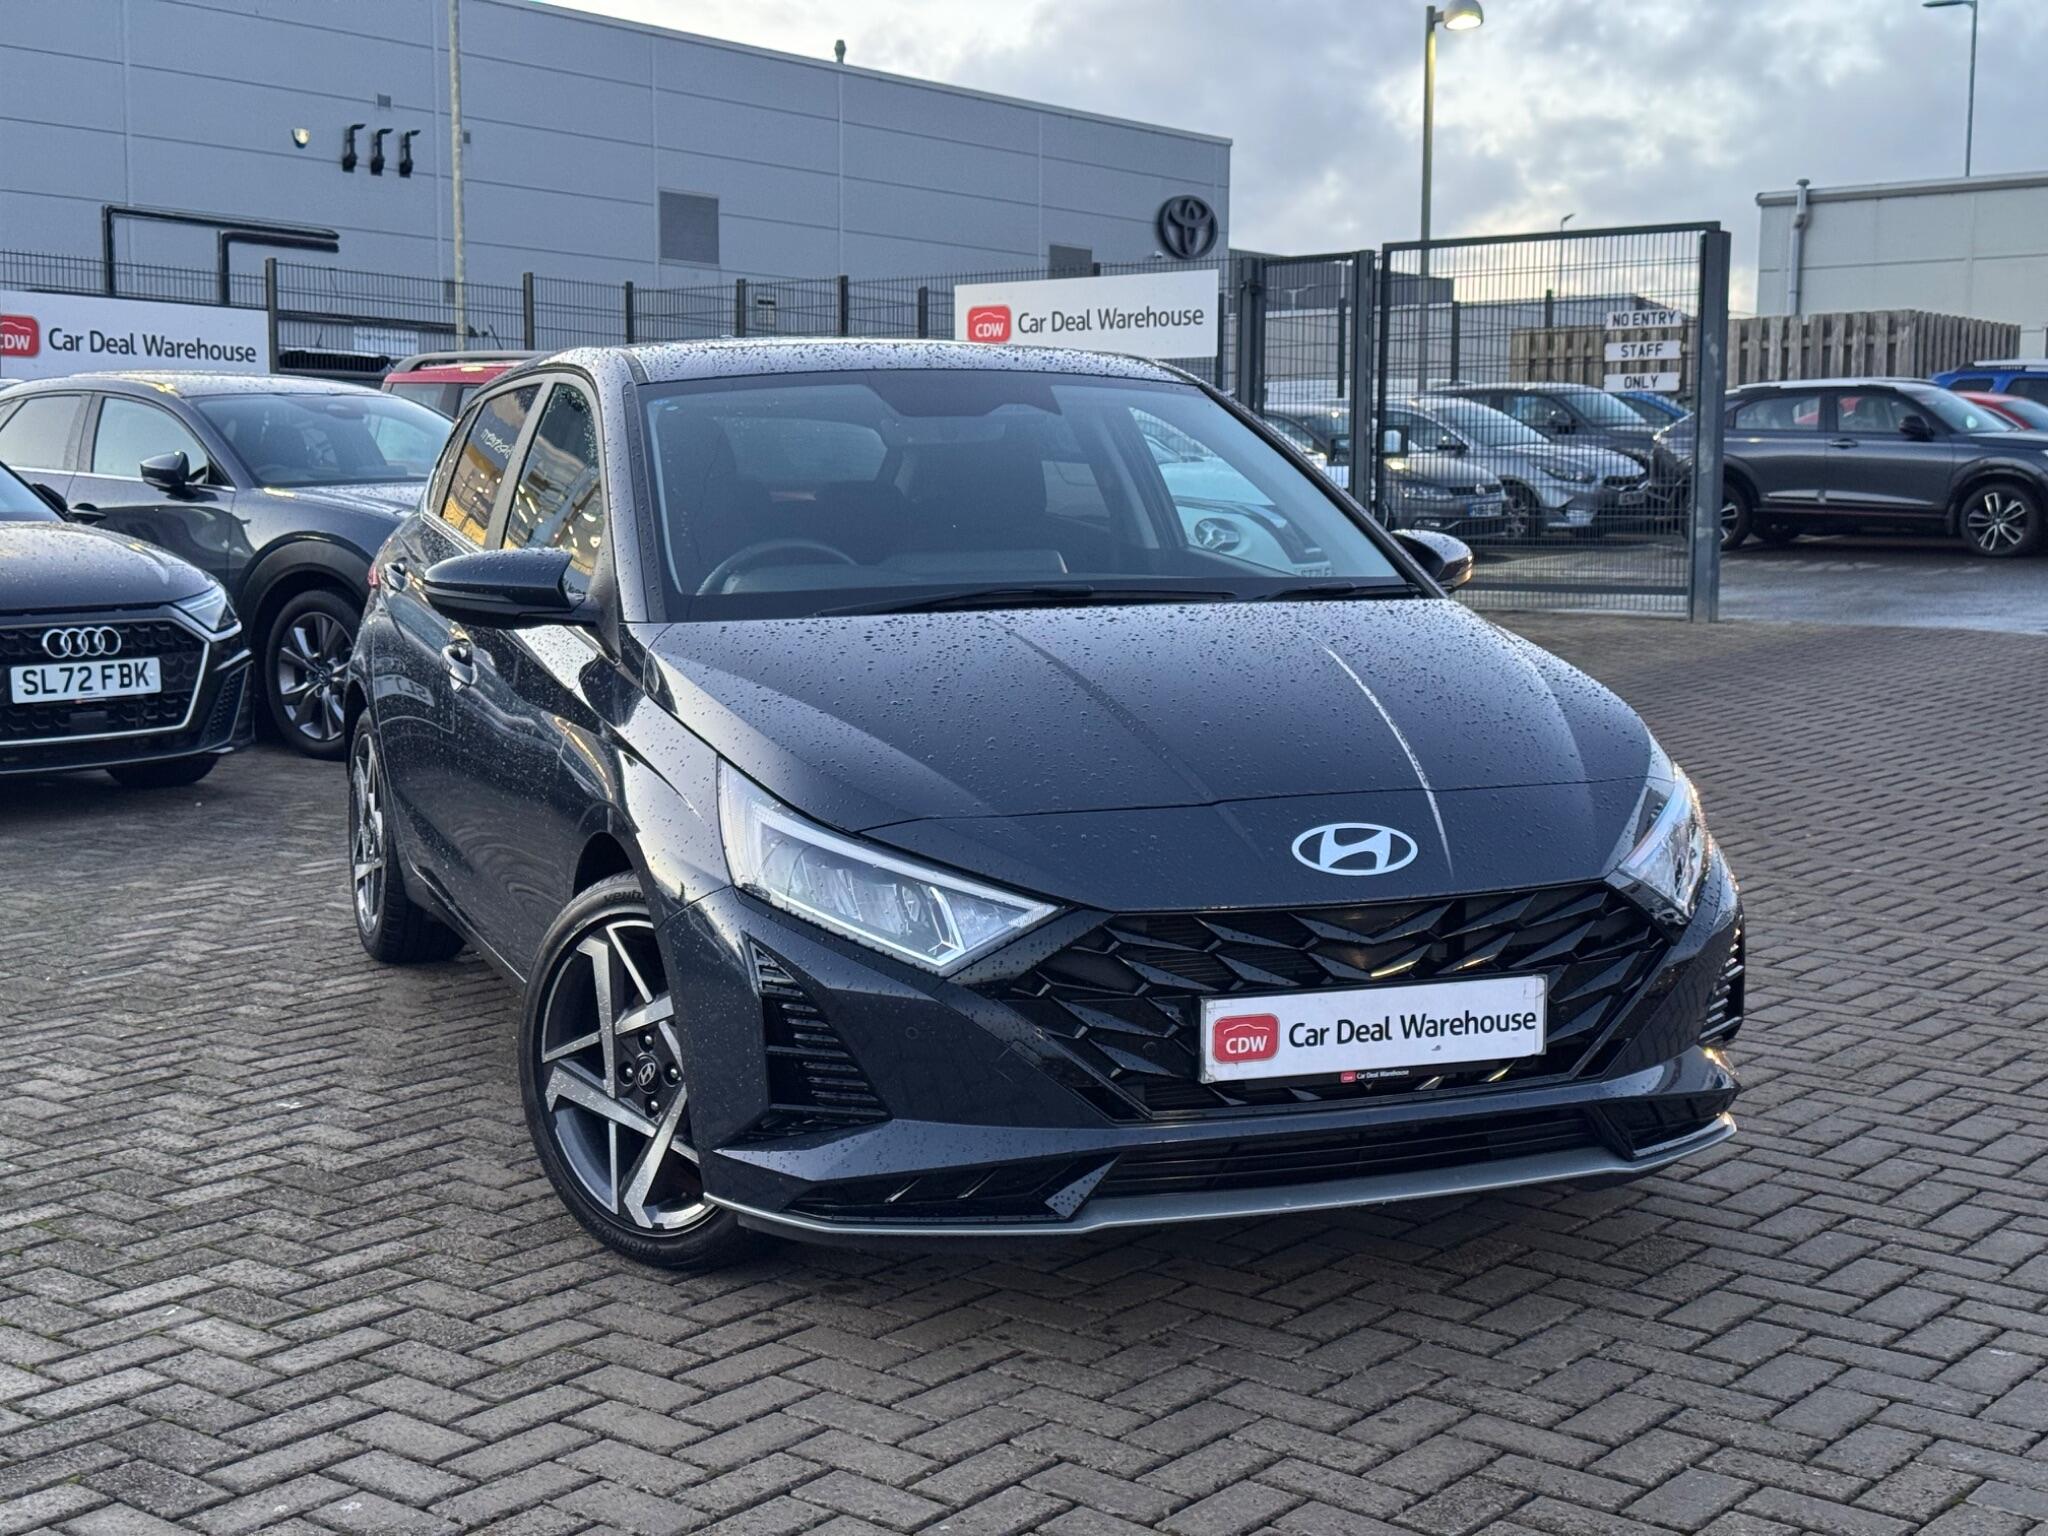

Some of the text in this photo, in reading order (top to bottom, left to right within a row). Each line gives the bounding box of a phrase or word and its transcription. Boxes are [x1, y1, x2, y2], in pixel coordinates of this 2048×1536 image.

[1018, 305, 1204, 333] Car Deal Warehouse
[1612, 311, 1676, 327] NO ENTRY
[975, 322, 1004, 337] CDW
[48, 327, 257, 363] Car Deal Warehouse
[1620, 343, 1664, 358] STAFF
[1624, 375, 1659, 389] ONLY
[22, 661, 149, 695] SL72 FBK
[1288, 1009, 1537, 1048] Car Deal Warehouse
[1226, 1035, 1268, 1054] CDW
